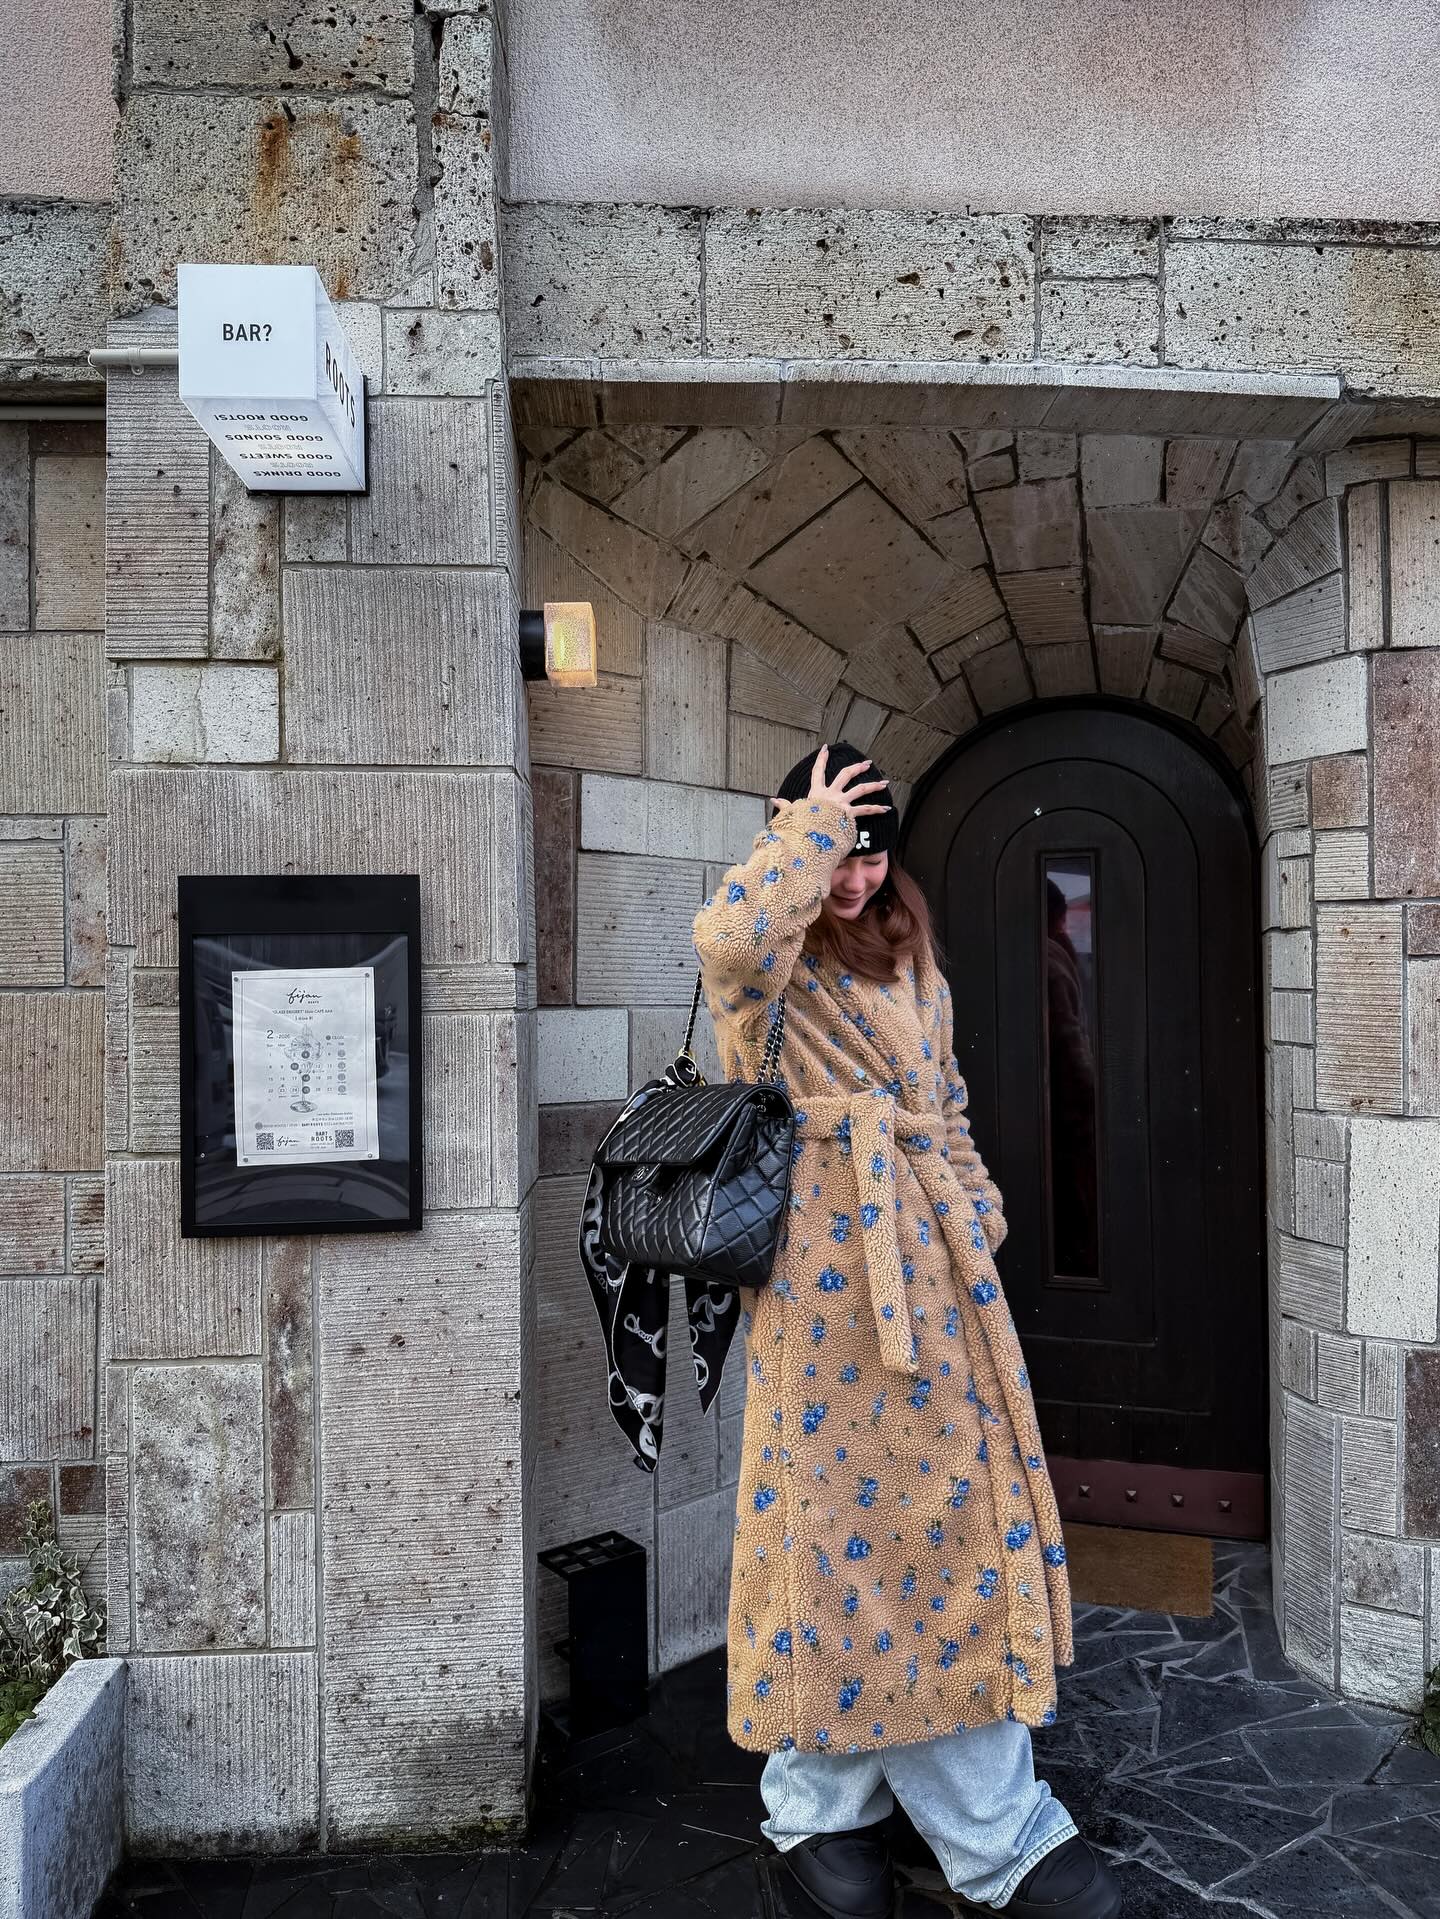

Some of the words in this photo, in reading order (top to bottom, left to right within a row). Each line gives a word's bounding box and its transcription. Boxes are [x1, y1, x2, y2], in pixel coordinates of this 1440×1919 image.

[223, 324, 272, 341] BAR?
[325, 341, 355, 428] ROOTS
[266, 1029, 274, 1039] 2
